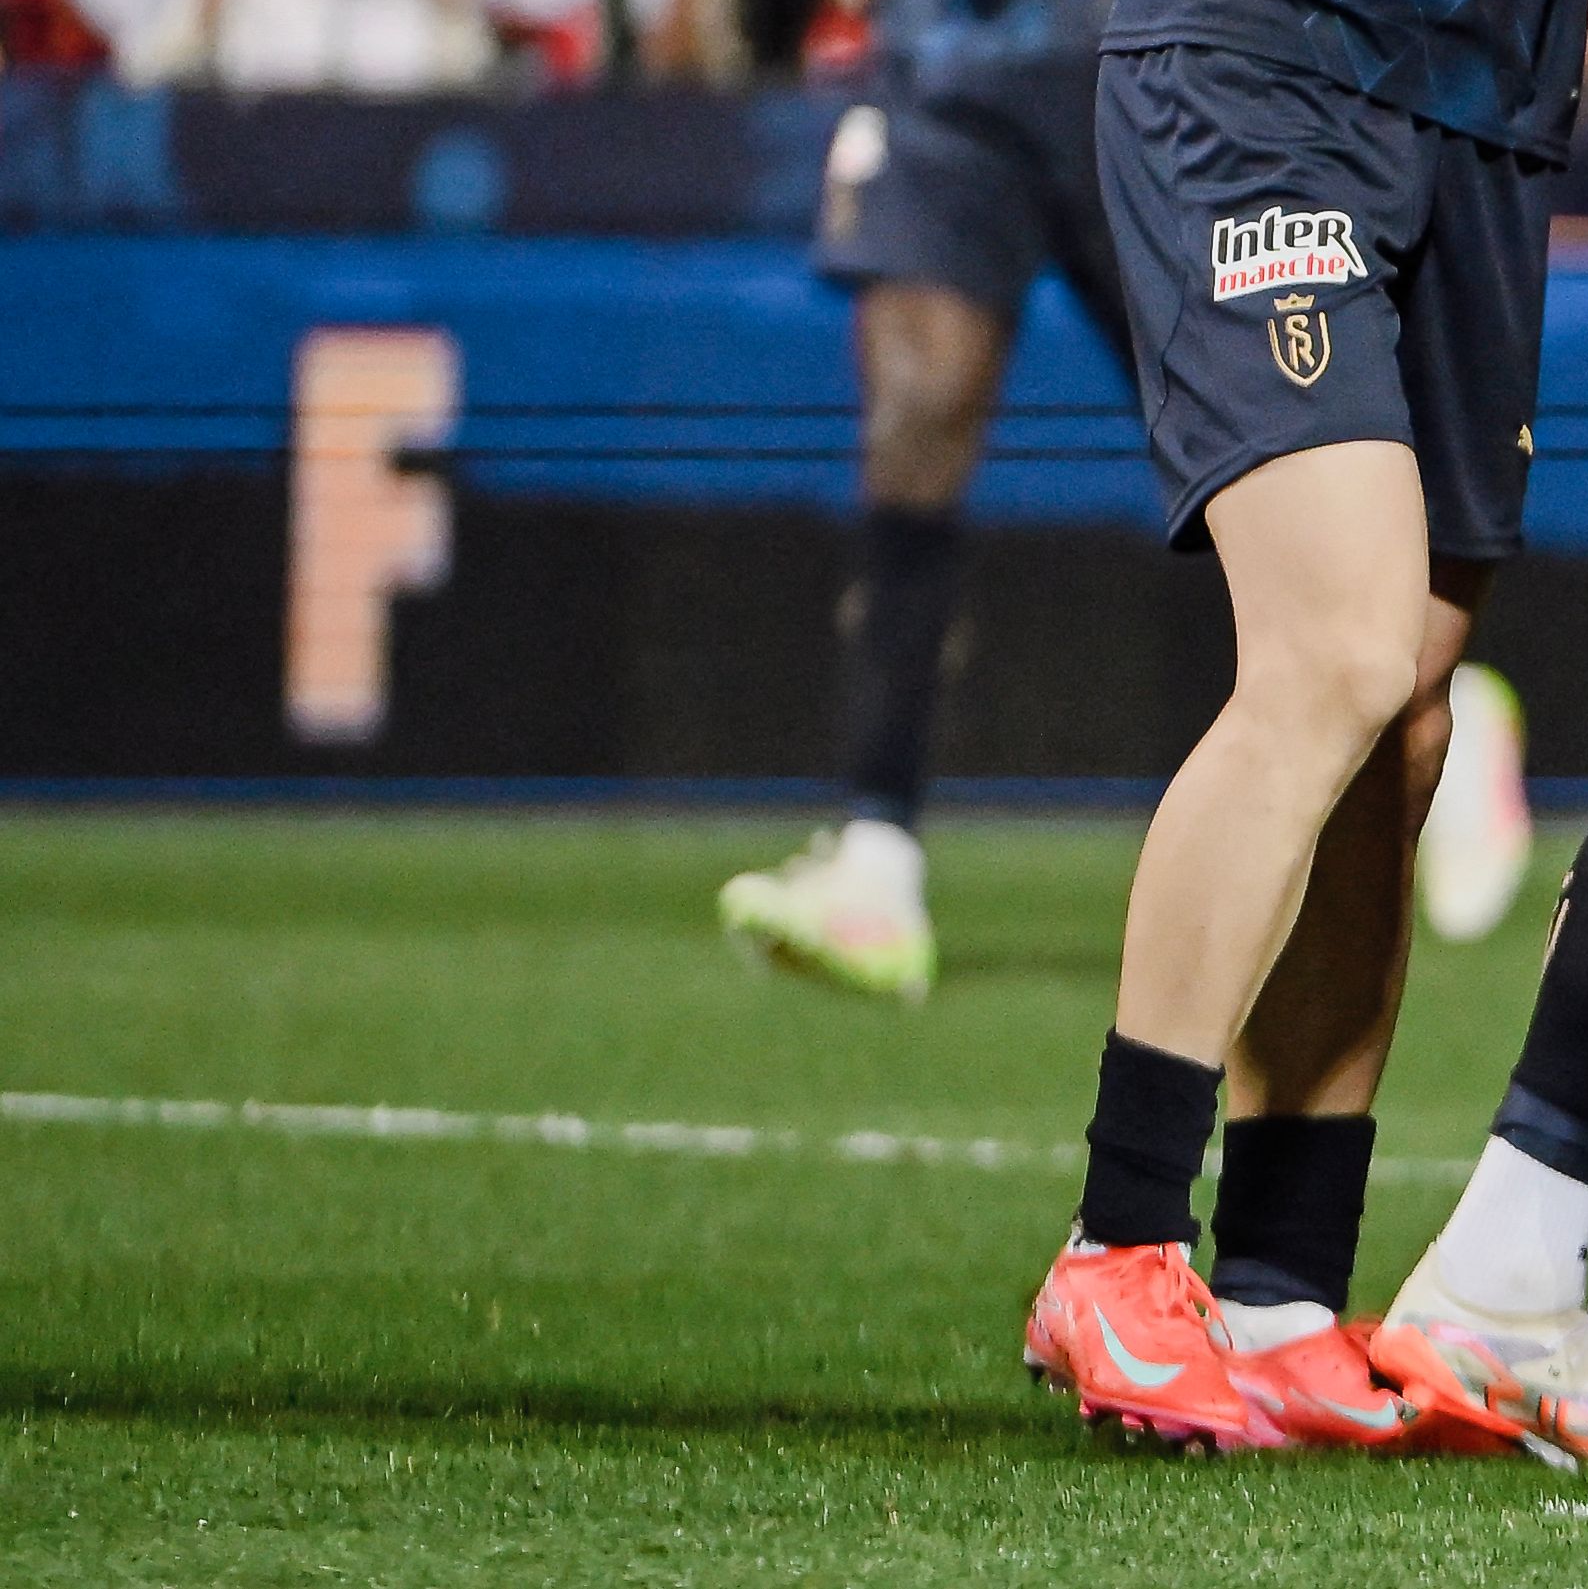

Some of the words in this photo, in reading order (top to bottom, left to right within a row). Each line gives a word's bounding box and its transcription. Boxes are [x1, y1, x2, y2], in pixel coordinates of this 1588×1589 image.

[1216, 214, 1361, 271] Inter
[1219, 252, 1345, 293] marche
[288, 325, 461, 738] F
